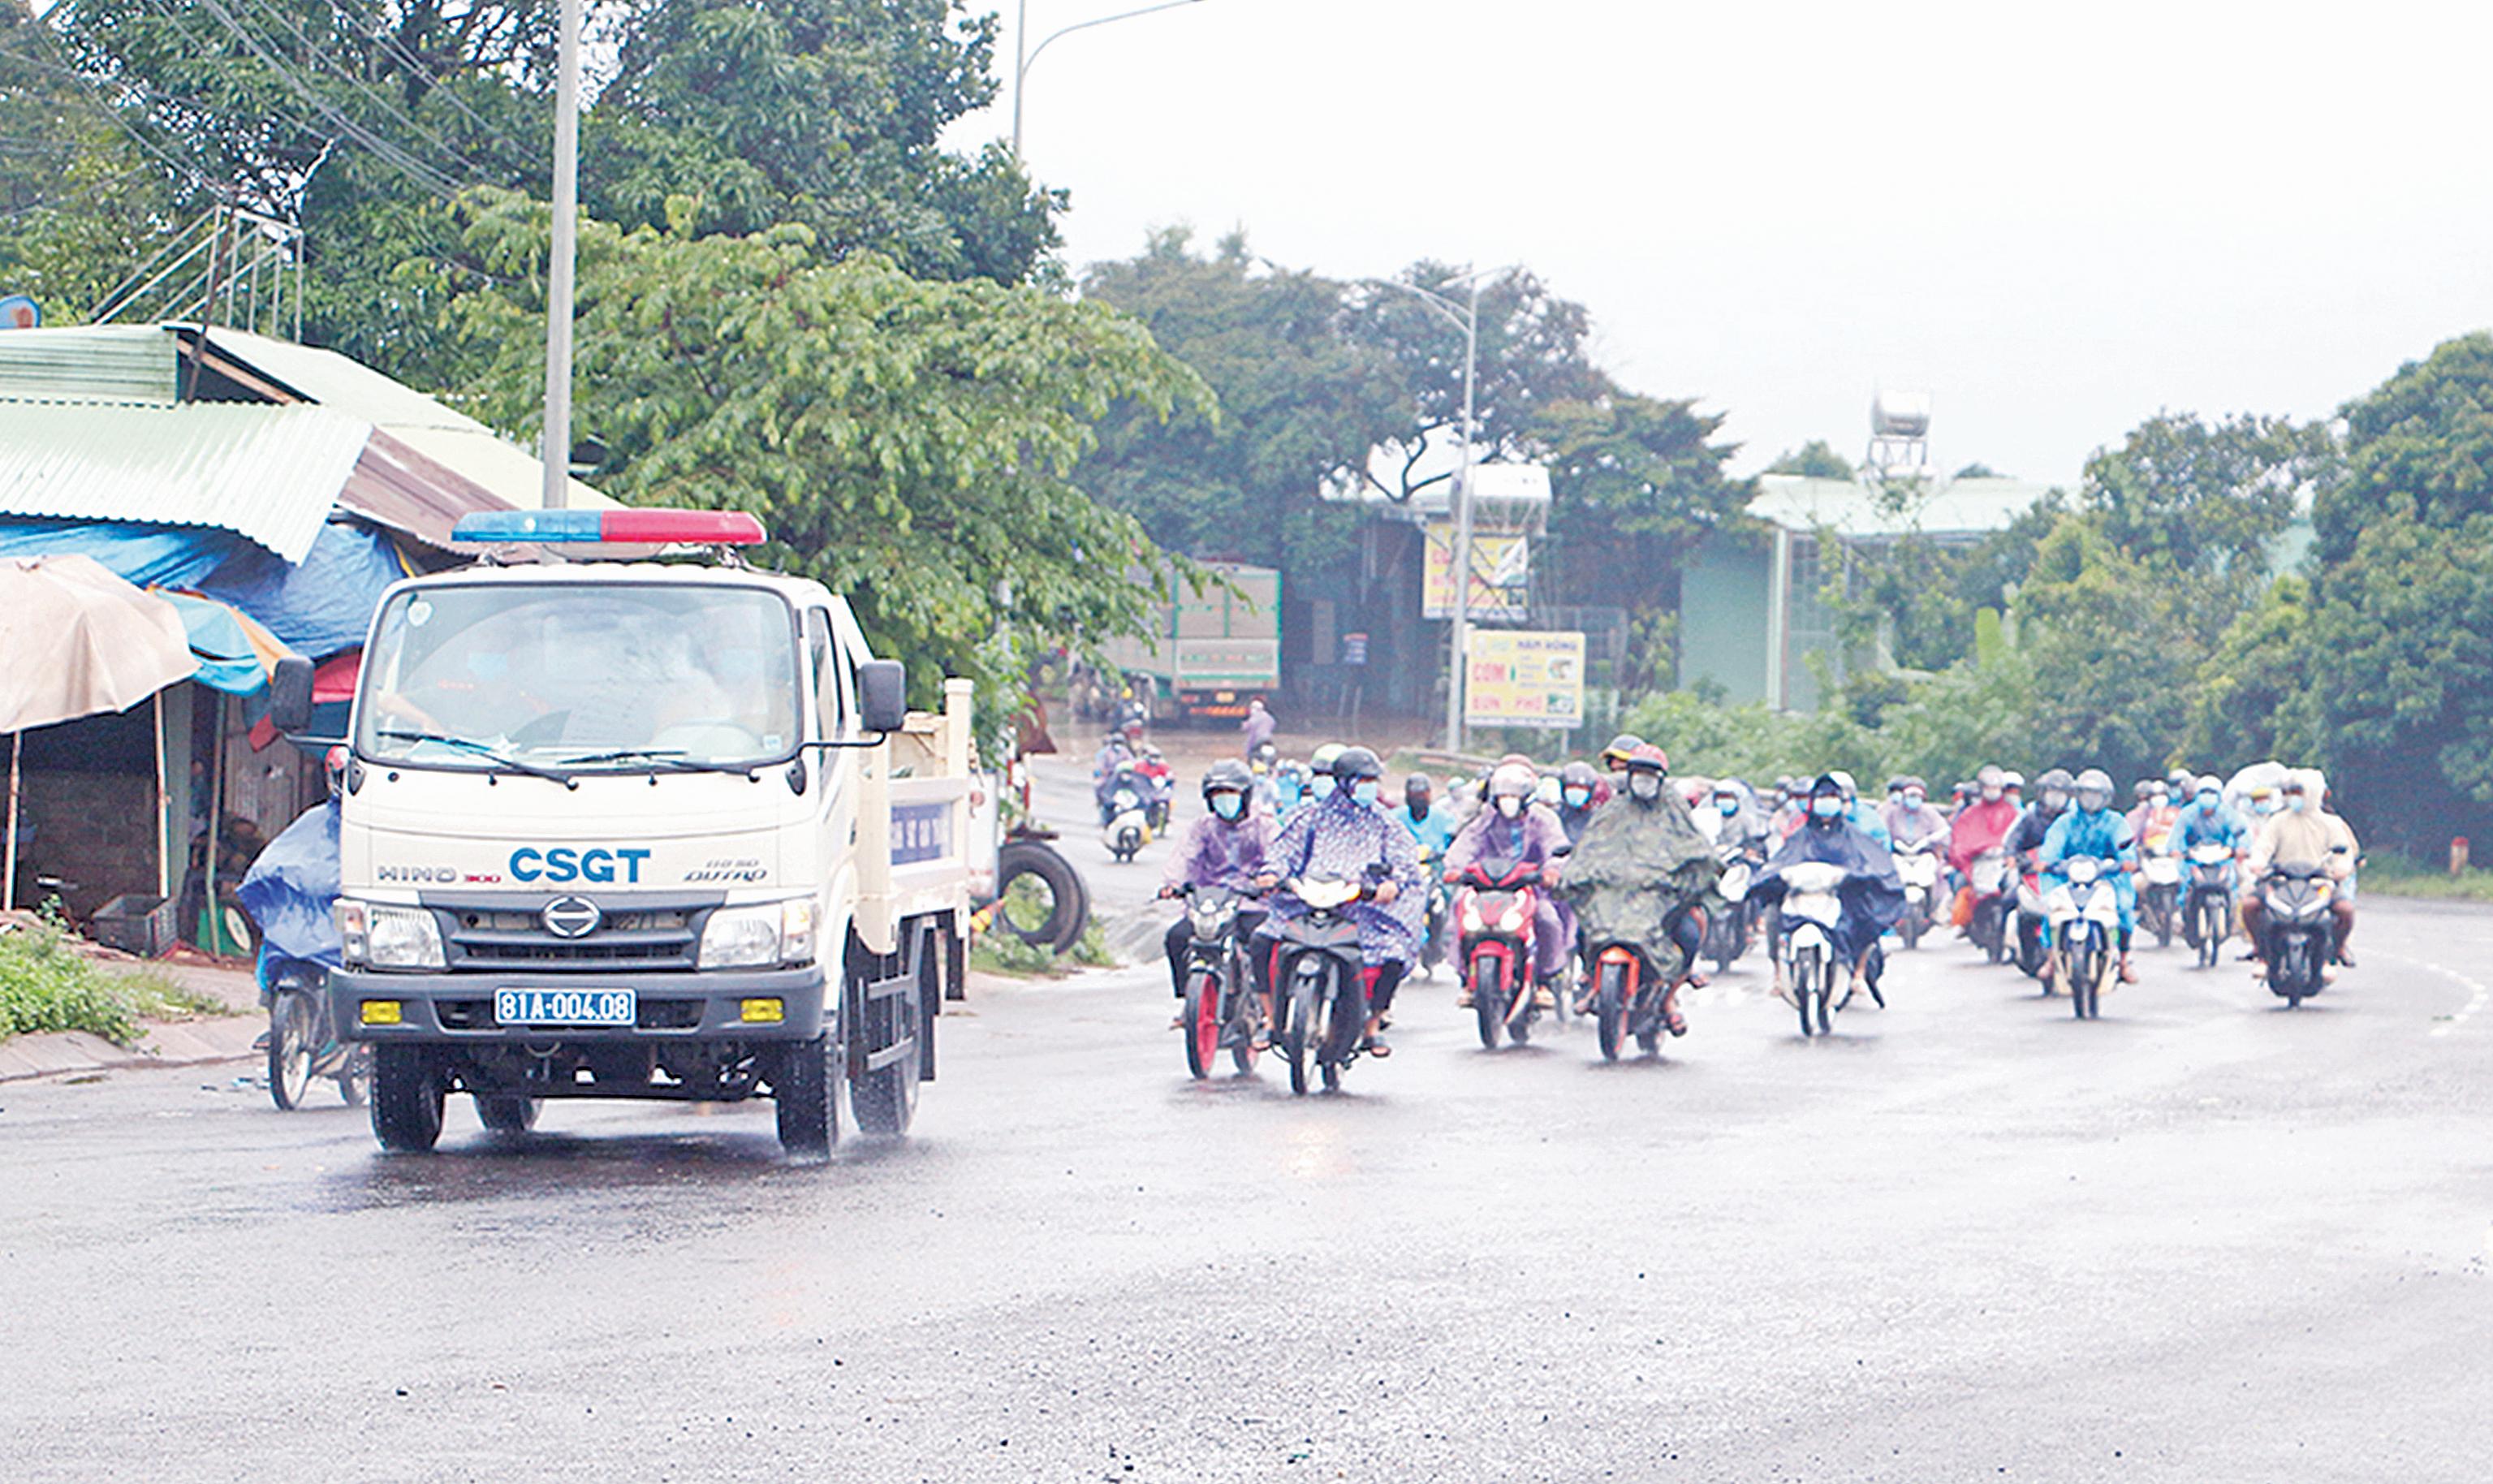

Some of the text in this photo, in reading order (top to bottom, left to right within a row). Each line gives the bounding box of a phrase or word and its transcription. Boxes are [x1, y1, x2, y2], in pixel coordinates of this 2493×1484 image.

[377, 865, 457, 883] HINO
[509, 847, 650, 883] CSGT
[501, 992, 629, 1020] 81A-004.08
